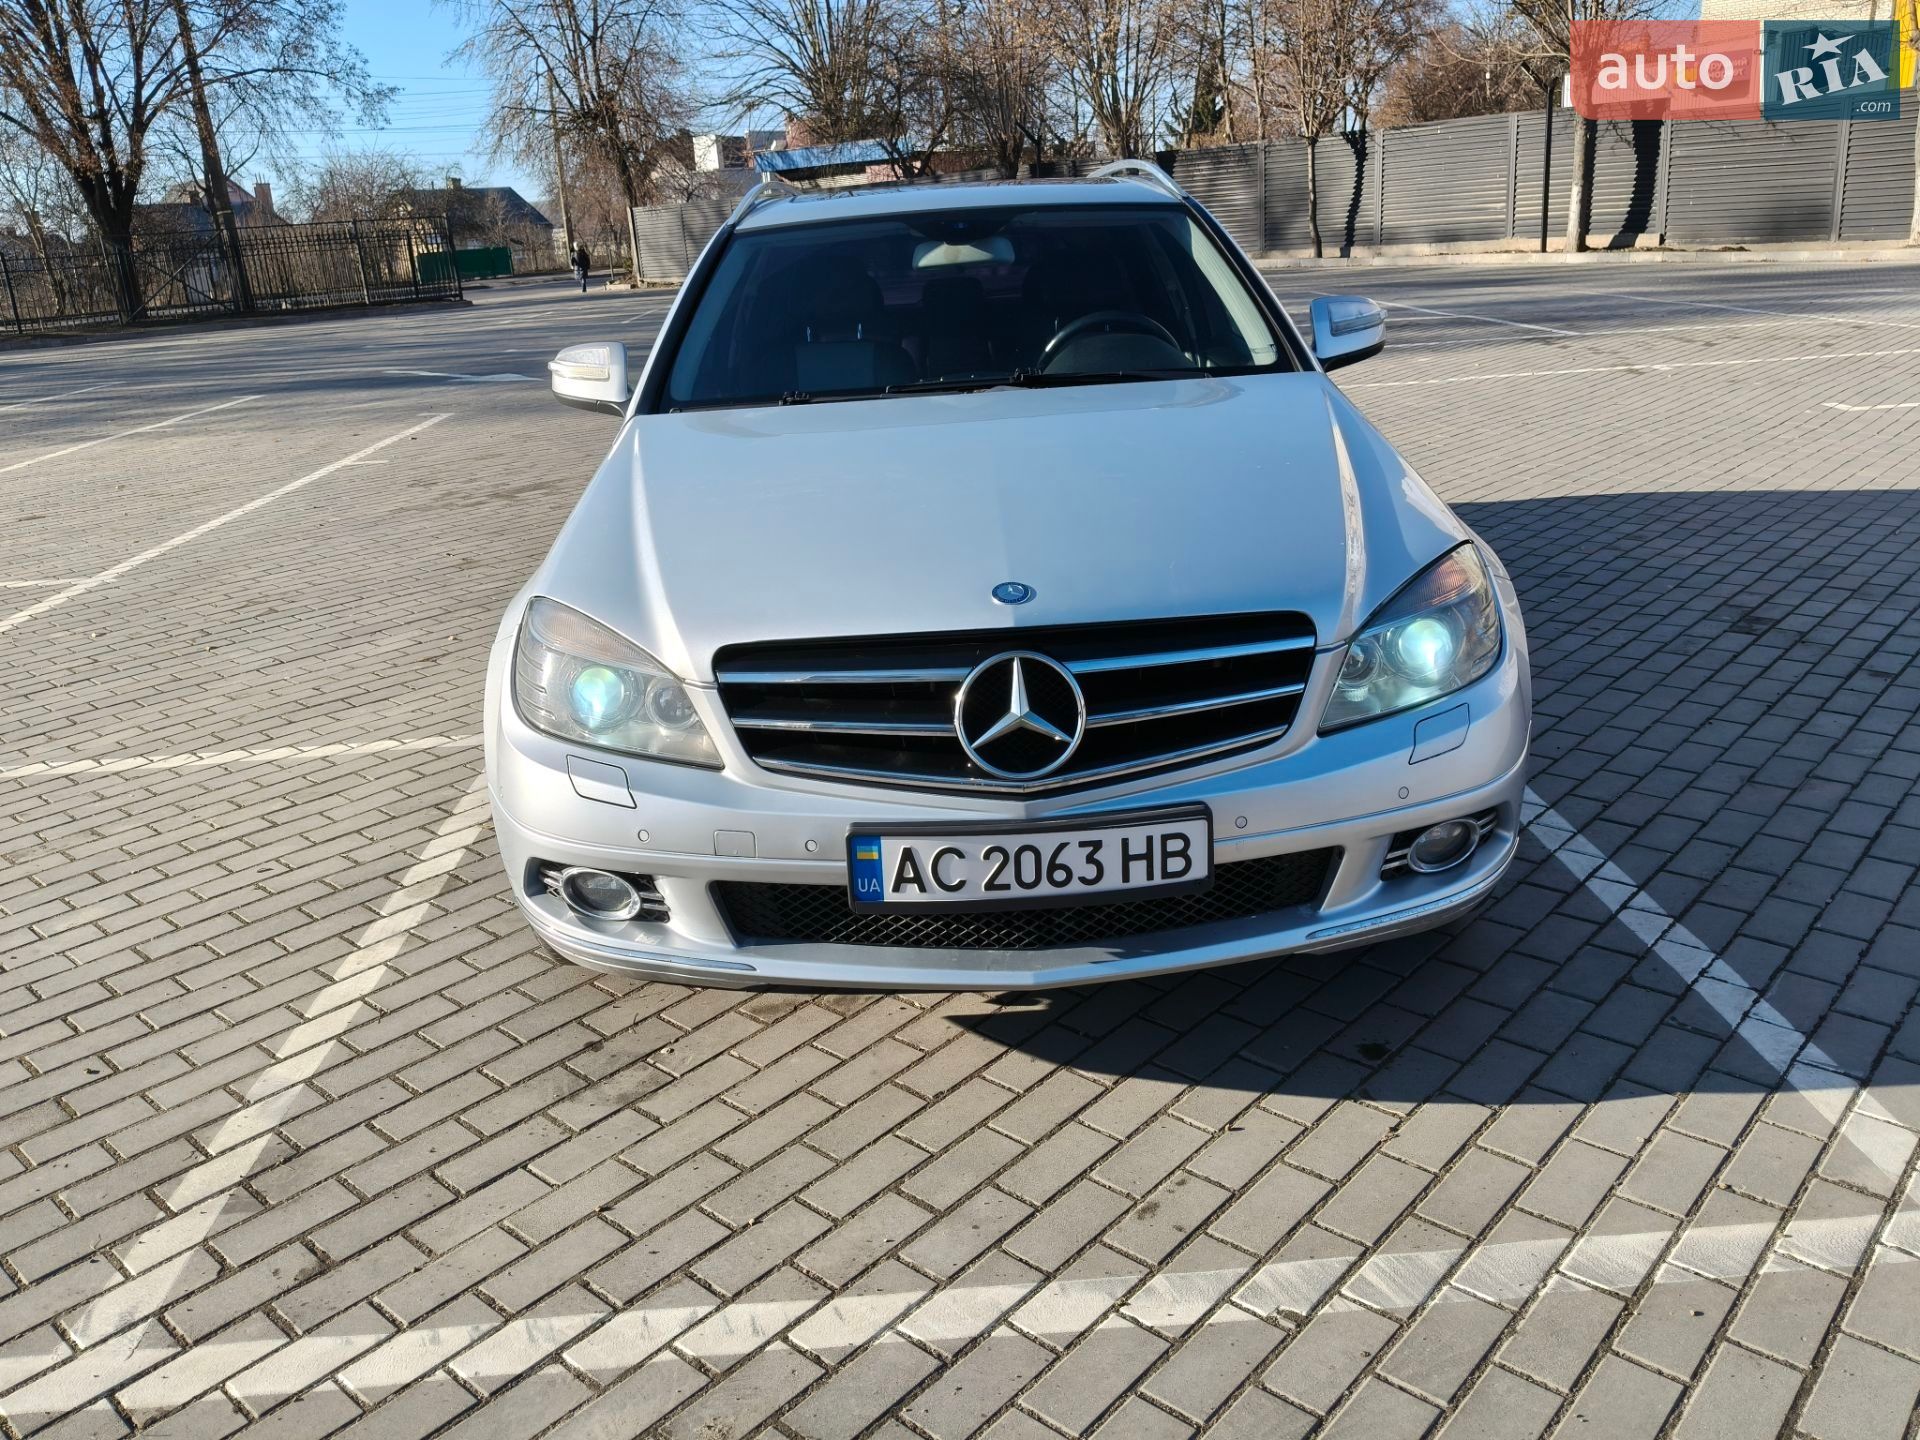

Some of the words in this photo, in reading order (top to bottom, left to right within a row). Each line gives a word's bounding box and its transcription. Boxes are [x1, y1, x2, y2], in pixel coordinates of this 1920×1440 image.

[891, 845, 967, 893] AC
[981, 839, 1105, 892] 2063
[1120, 832, 1193, 884] HB
[857, 877, 881, 893] UA
